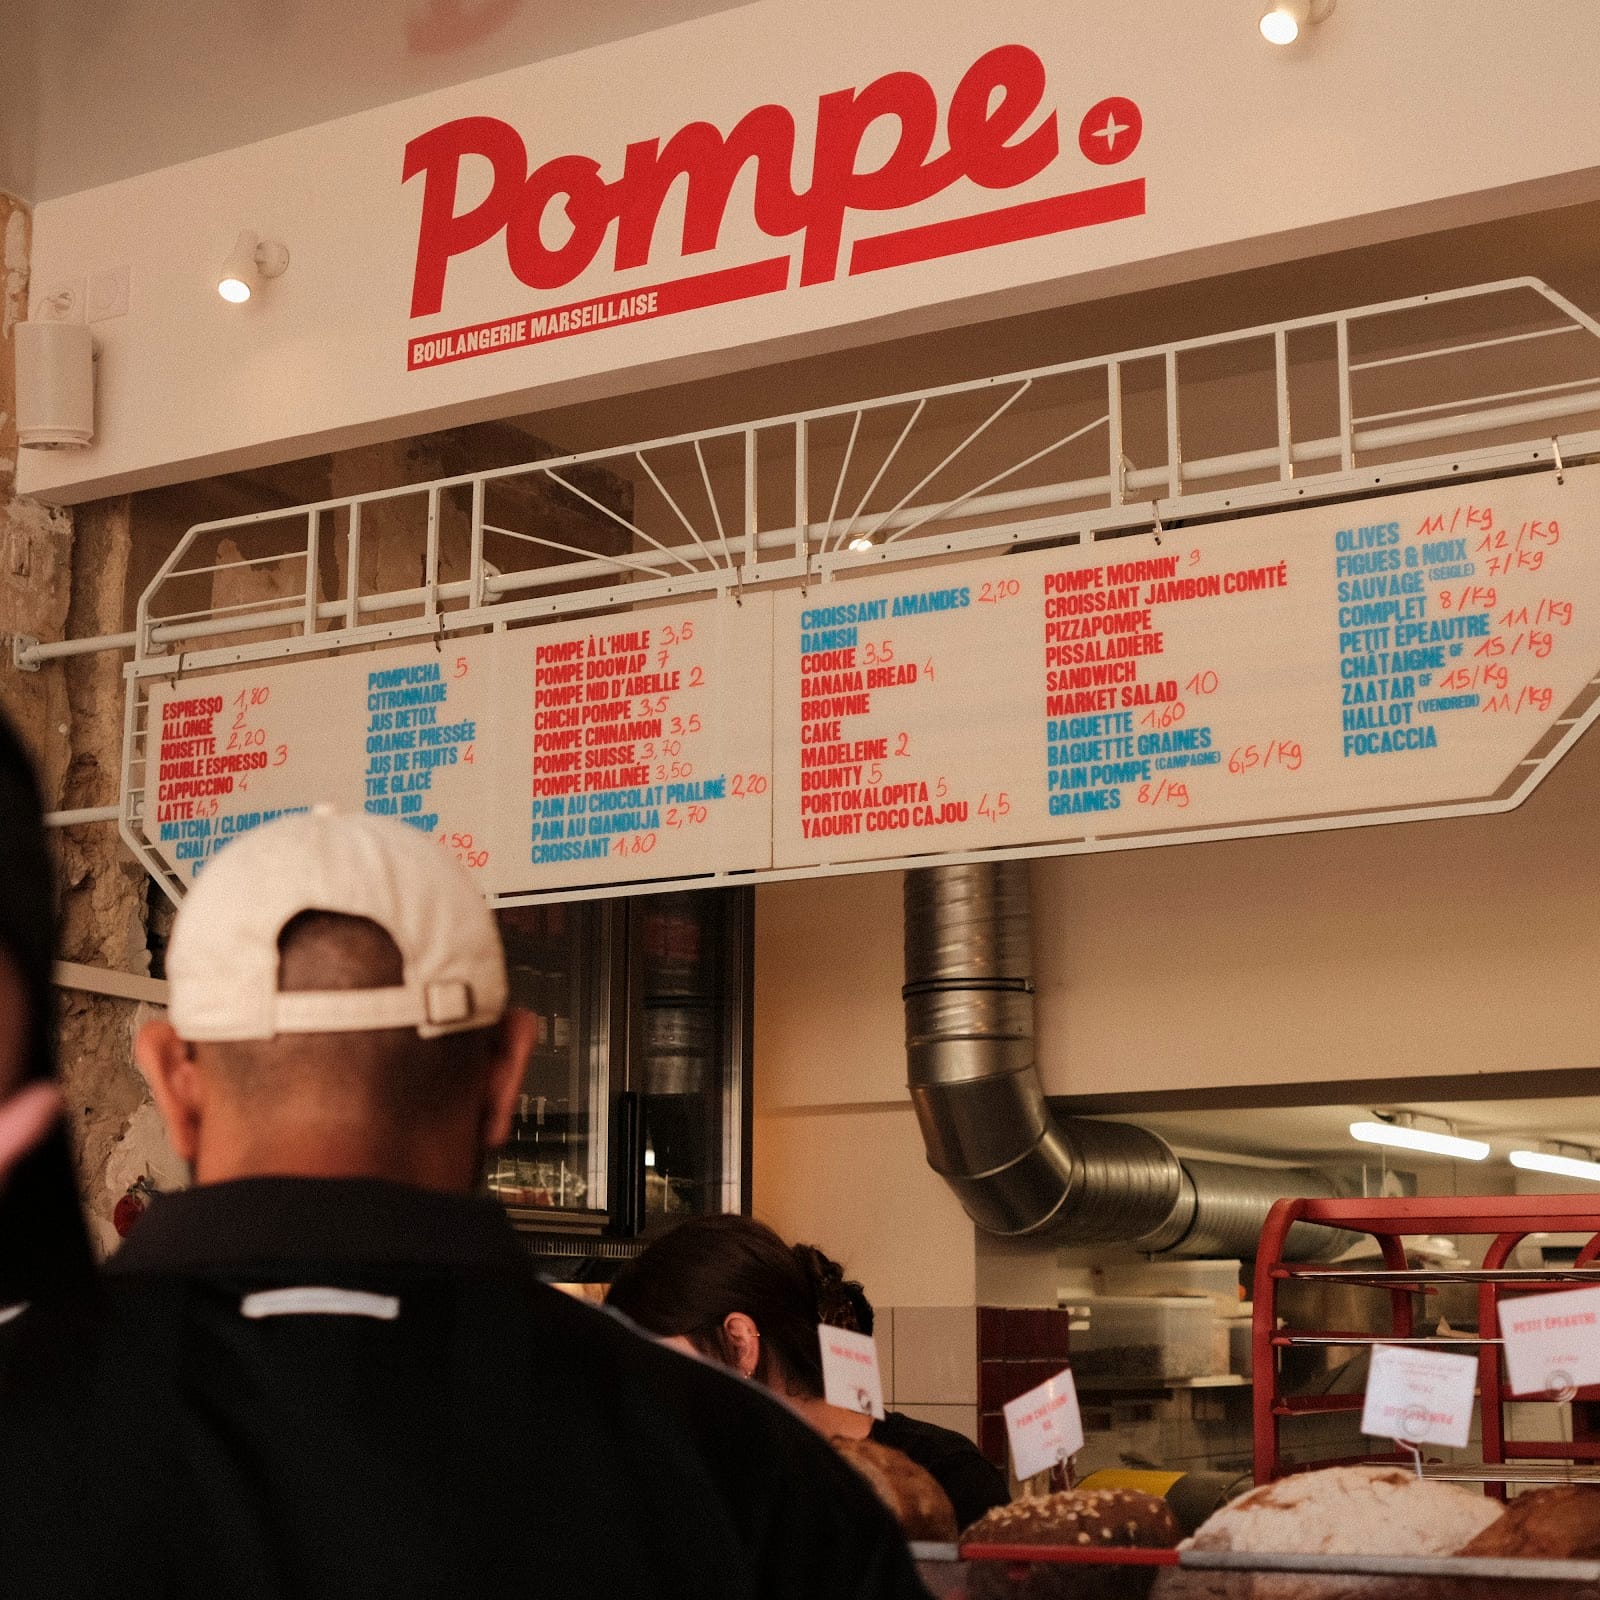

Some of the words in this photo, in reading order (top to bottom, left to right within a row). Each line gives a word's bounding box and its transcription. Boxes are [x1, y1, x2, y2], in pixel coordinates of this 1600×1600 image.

[401, 43, 1060, 319] Pompe
[413, 320, 526, 365] BOULANGERIE
[530, 292, 659, 339] MARSEILLAISE
[1335, 522, 1399, 552] OLIVES
[1188, 549, 1200, 566] 9
[1336, 550, 1400, 578] FIGUES
[1405, 546, 1418, 567] &
[1423, 539, 1467, 566] NOIX
[1044, 568, 1103, 594] POMPE
[1107, 555, 1180, 586] MORNIN'
[1338, 570, 1424, 602] SAUVAGE
[1045, 586, 1139, 618] CROISSANT
[1145, 575, 1220, 605] JAMBON
[1224, 560, 1287, 593] COMTÉ
[801, 598, 888, 630] CROISSANT
[892, 587, 970, 617] AMANDES
[1339, 596, 1427, 628] COMPLET
[660, 621, 694, 646] 3,5
[801, 627, 857, 653] DANISH
[1045, 609, 1151, 643] PIZZAPOMPE
[1340, 626, 1390, 654] PETIT
[536, 640, 584, 665] POMPE
[587, 634, 596, 657] À
[600, 630, 650, 656] L'HUILE
[658, 650, 669, 669] 7
[801, 648, 856, 675] COOKIE
[863, 640, 894, 666] 3,5
[1046, 630, 1163, 667] PISSALADIÈRE
[368, 662, 440, 691] POMPUCHA
[454, 657, 468, 678] 5
[536, 662, 583, 687] POMPE
[587, 653, 646, 680] DOOWAP
[923, 655, 935, 682] 4
[1046, 661, 1136, 691] SANDWICH
[1341, 646, 1445, 679] CHÂTAIGNE
[535, 684, 582, 709] POMPE
[586, 681, 608, 702] NID
[612, 670, 680, 699] D'ABEILLE
[689, 666, 704, 688] 2
[801, 671, 863, 698] BANANA
[867, 663, 917, 689] BREAD
[1186, 670, 1218, 695] 10
[1342, 676, 1415, 706] ZAATAR
[1419, 673, 1433, 687] GF
[162, 696, 223, 720] ESPRESSO
[233, 687, 270, 711] 1,80
[367, 682, 448, 712] CITRONNADE
[637, 696, 669, 717] 3,5
[801, 693, 870, 721] BROWNIE
[1047, 688, 1117, 716] MARKET
[1121, 680, 1177, 707] SALAD
[232, 712, 247, 730] 2
[367, 712, 393, 733] JUS
[395, 706, 437, 729] DETOX
[535, 707, 579, 730] CHICHI
[581, 700, 631, 725] POMPE
[670, 714, 701, 735] 3,5
[1047, 711, 1133, 742] BAGUETTE
[1141, 702, 1185, 728] 1,60
[1343, 702, 1413, 732] HALLOT
[226, 729, 266, 750] 2,20
[366, 730, 416, 754] ORANGE
[418, 718, 476, 747] PRESSÉE
[534, 729, 582, 752] POMPE
[585, 718, 661, 746] CINNAMON
[801, 721, 841, 744] CAKE
[895, 732, 911, 757] 2
[1047, 736, 1133, 766] BAGUETTE
[1138, 727, 1212, 755] GRAINES
[1343, 725, 1438, 758] FOCACCIA
[160, 737, 216, 761] NOISETTE
[272, 744, 288, 766] 3
[365, 755, 391, 775] JUS
[394, 752, 410, 772] DE
[412, 746, 458, 769] FRUITS
[463, 744, 474, 765] 4
[533, 751, 581, 775] POMPE
[585, 745, 635, 769] SUISSE
[640, 740, 681, 761] 3,70
[801, 738, 888, 768] MADELEINE
[159, 758, 204, 781] DOUBLE
[206, 751, 268, 775] ESPRESSO
[533, 773, 581, 797] POMPE
[585, 762, 649, 791] PRALINÉE
[656, 761, 693, 781] 3,50
[801, 765, 862, 792] BOUNTY
[867, 763, 882, 785] 5
[1048, 768, 1087, 791] PAIN
[1091, 759, 1151, 786] POMPE
[1156, 751, 1221, 770] (CAMPAGNE)
[158, 776, 233, 801] CAPPUCCINO
[238, 773, 249, 791] 4
[533, 797, 564, 819] PAIN
[568, 795, 586, 815] AU
[589, 786, 663, 812] CHOCOLAT
[666, 773, 726, 804] PRALINÉ
[731, 774, 767, 799] 2,20
[935, 776, 947, 797] 5
[157, 801, 193, 822] LATTE
[364, 797, 398, 815] SODA
[401, 794, 422, 815] BIO
[801, 781, 929, 816] PORTOKALOPITA
[978, 793, 1010, 823] 4,5
[1049, 789, 1120, 816] GRAINES
[160, 818, 211, 841] MATCHA
[221, 812, 260, 834] CLOUD
[532, 819, 563, 841] PAIN
[567, 817, 586, 838] AU
[589, 810, 660, 836] GIANDUJA
[666, 806, 707, 828] 2,70
[801, 814, 862, 839] YAOURT
[866, 806, 909, 832] COCO
[912, 801, 968, 827] CAJOU
[176, 840, 203, 860] CHAI
[531, 837, 610, 864] CROISSANT
[612, 833, 656, 856] 1,80
